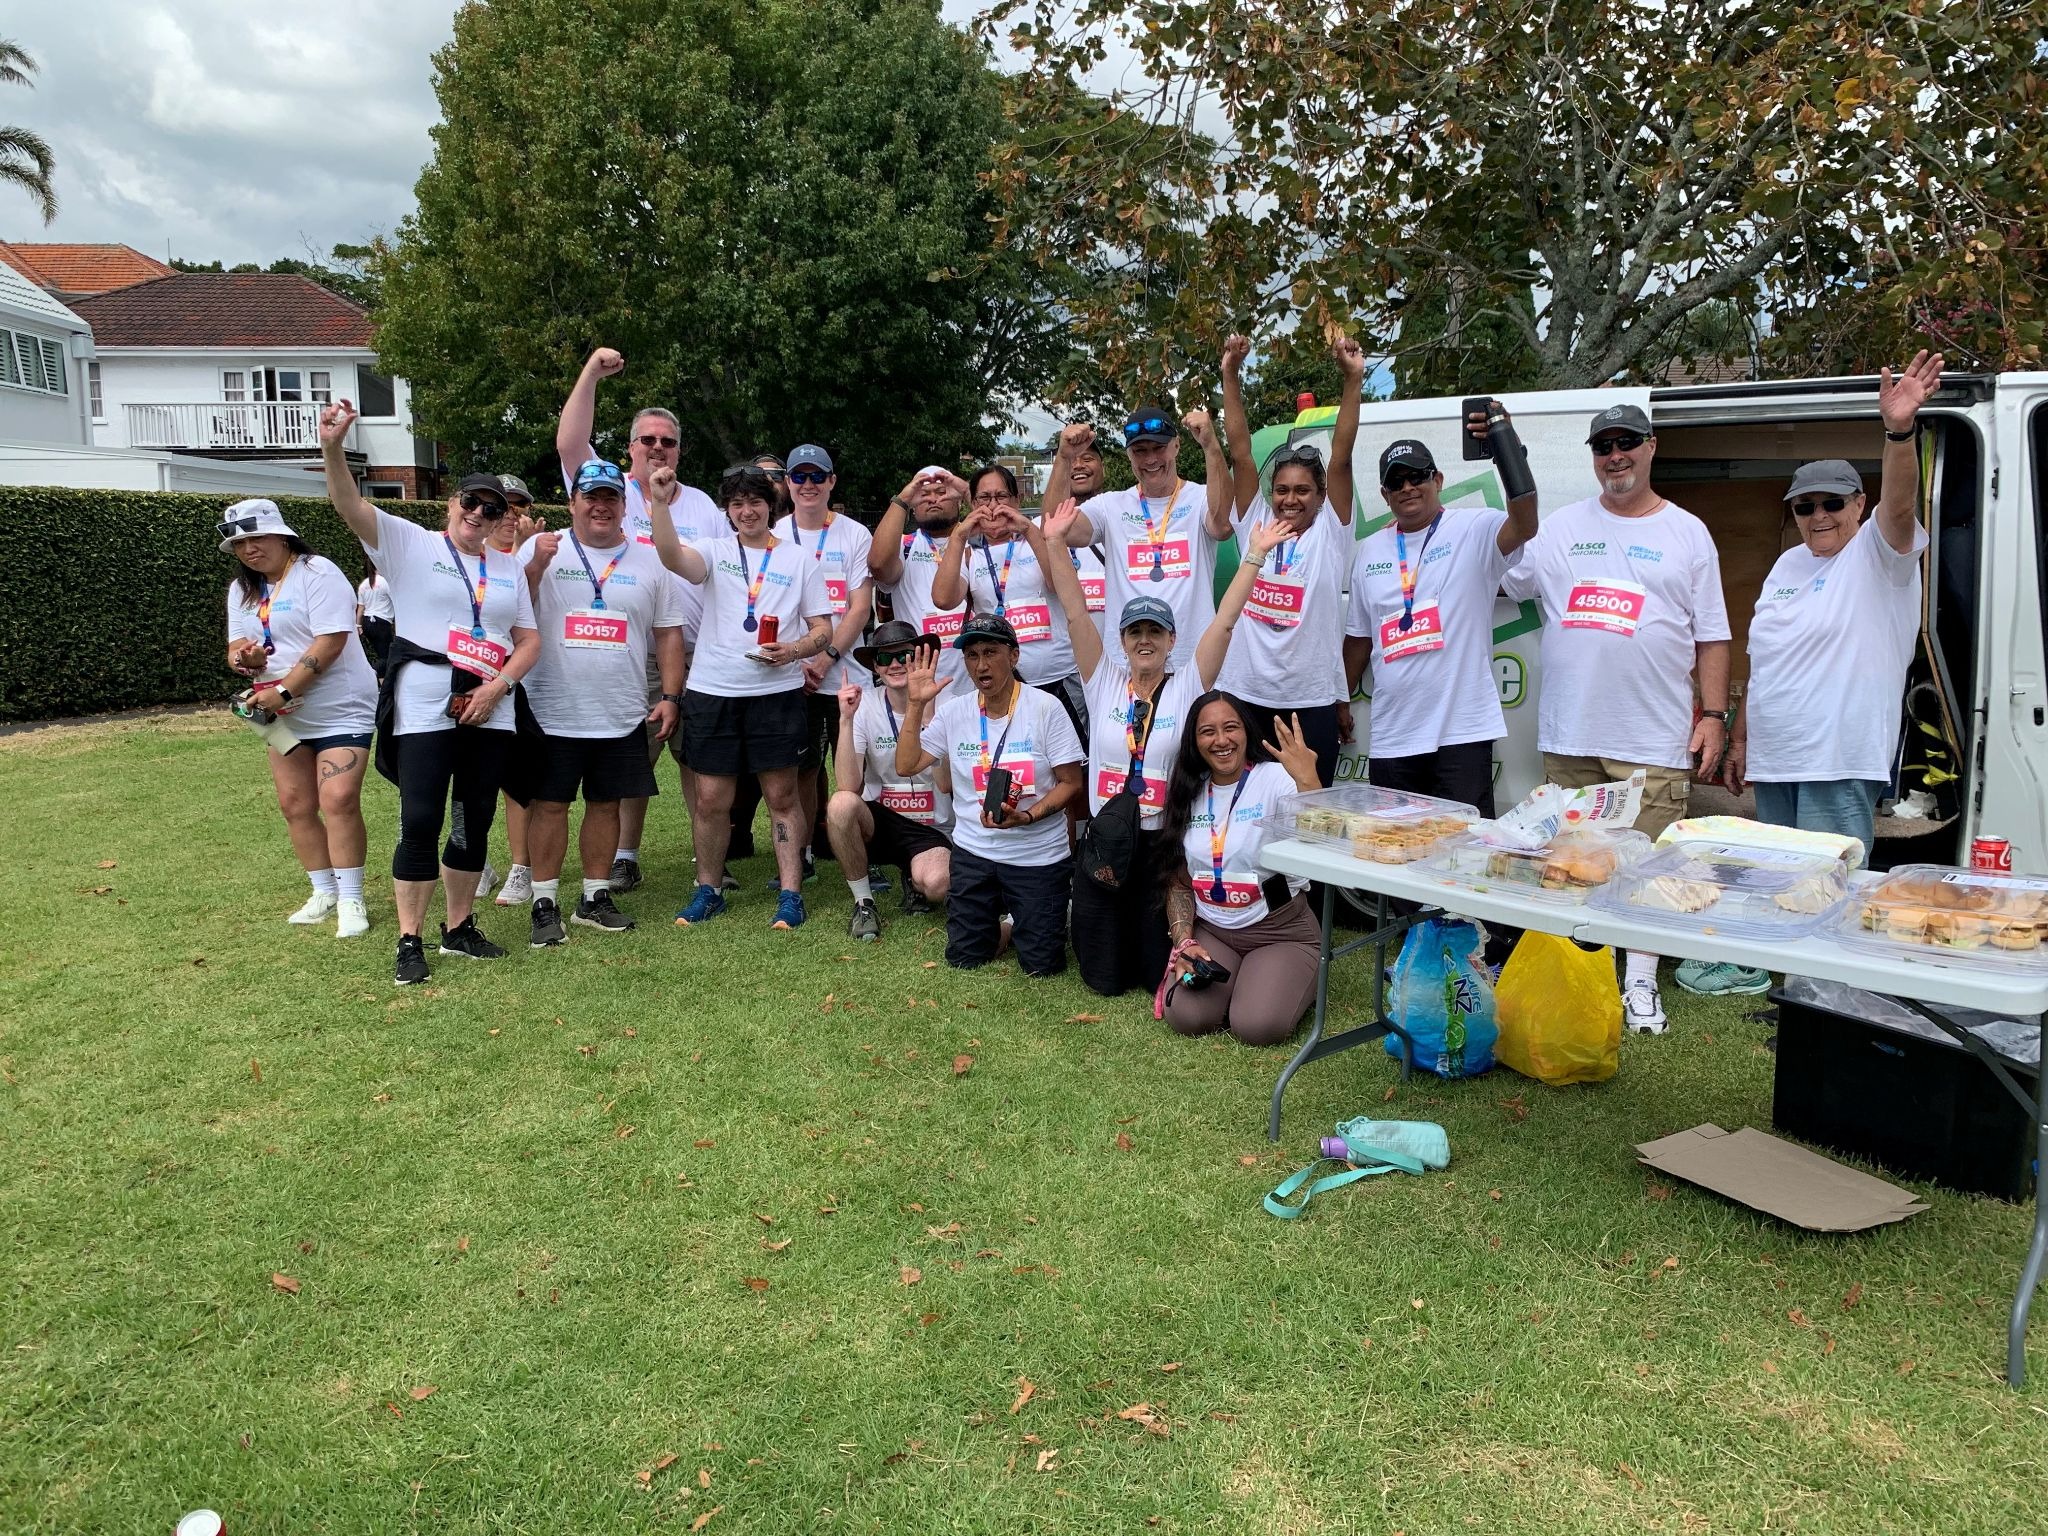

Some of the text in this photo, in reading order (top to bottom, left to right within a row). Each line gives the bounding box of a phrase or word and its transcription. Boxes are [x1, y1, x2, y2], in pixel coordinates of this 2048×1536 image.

[1137, 549, 1180, 563] 5078
[1429, 550, 1451, 562] CLEAN
[1629, 546, 1654, 554] FRESH
[1634, 553, 1661, 562] CLEAN
[556, 568, 588, 577] ALSCO
[717, 566, 744, 578] UNIFORM
[719, 560, 744, 573] ALSC
[1366, 562, 1392, 572] ALSCO
[1252, 587, 1294, 606] 50153
[1575, 594, 1633, 613] 45900
[574, 623, 619, 638] 50157
[929, 621, 963, 634] 5016
[1388, 617, 1431, 641] 5062
[456, 639, 499, 664] 50159
[958, 743, 982, 751] ALSC
[883, 798, 928, 809] 60060
[1595, 787, 1606, 808] PARTY
[1190, 814, 1216, 822] LSCO
[1203, 889, 1251, 903] 5169
[1453, 977, 1474, 1015] NZ
